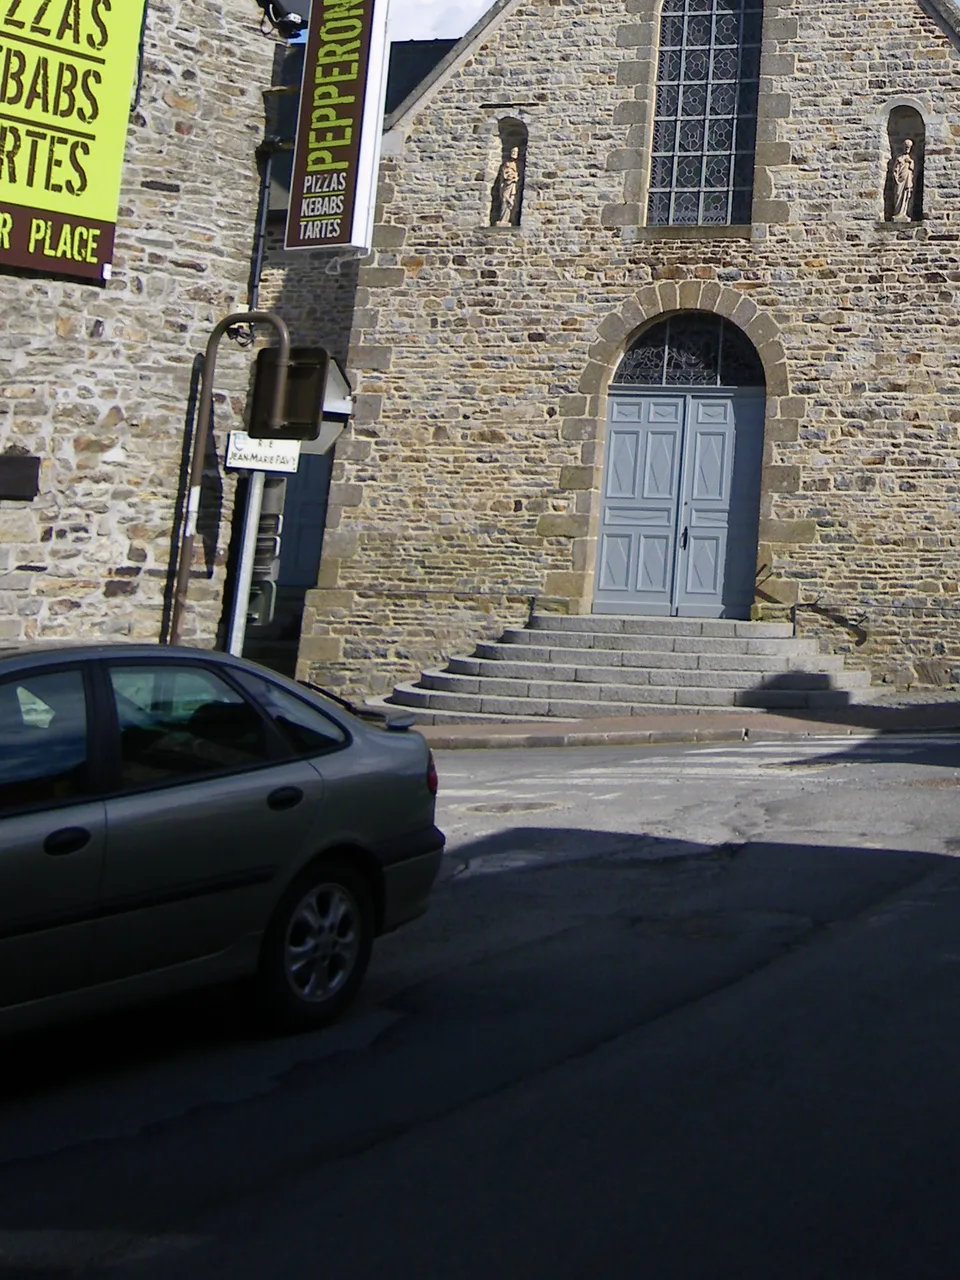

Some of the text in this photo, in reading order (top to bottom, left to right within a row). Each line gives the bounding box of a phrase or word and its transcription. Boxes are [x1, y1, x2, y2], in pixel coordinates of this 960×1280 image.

[0, 44, 102, 124] BABS
[0, 124, 90, 197] RTES
[303, 172, 347, 193] PIZZAS
[300, 195, 344, 217] KEBABS
[28, 218, 101, 264] PLACE
[299, 219, 341, 240] TARTES
